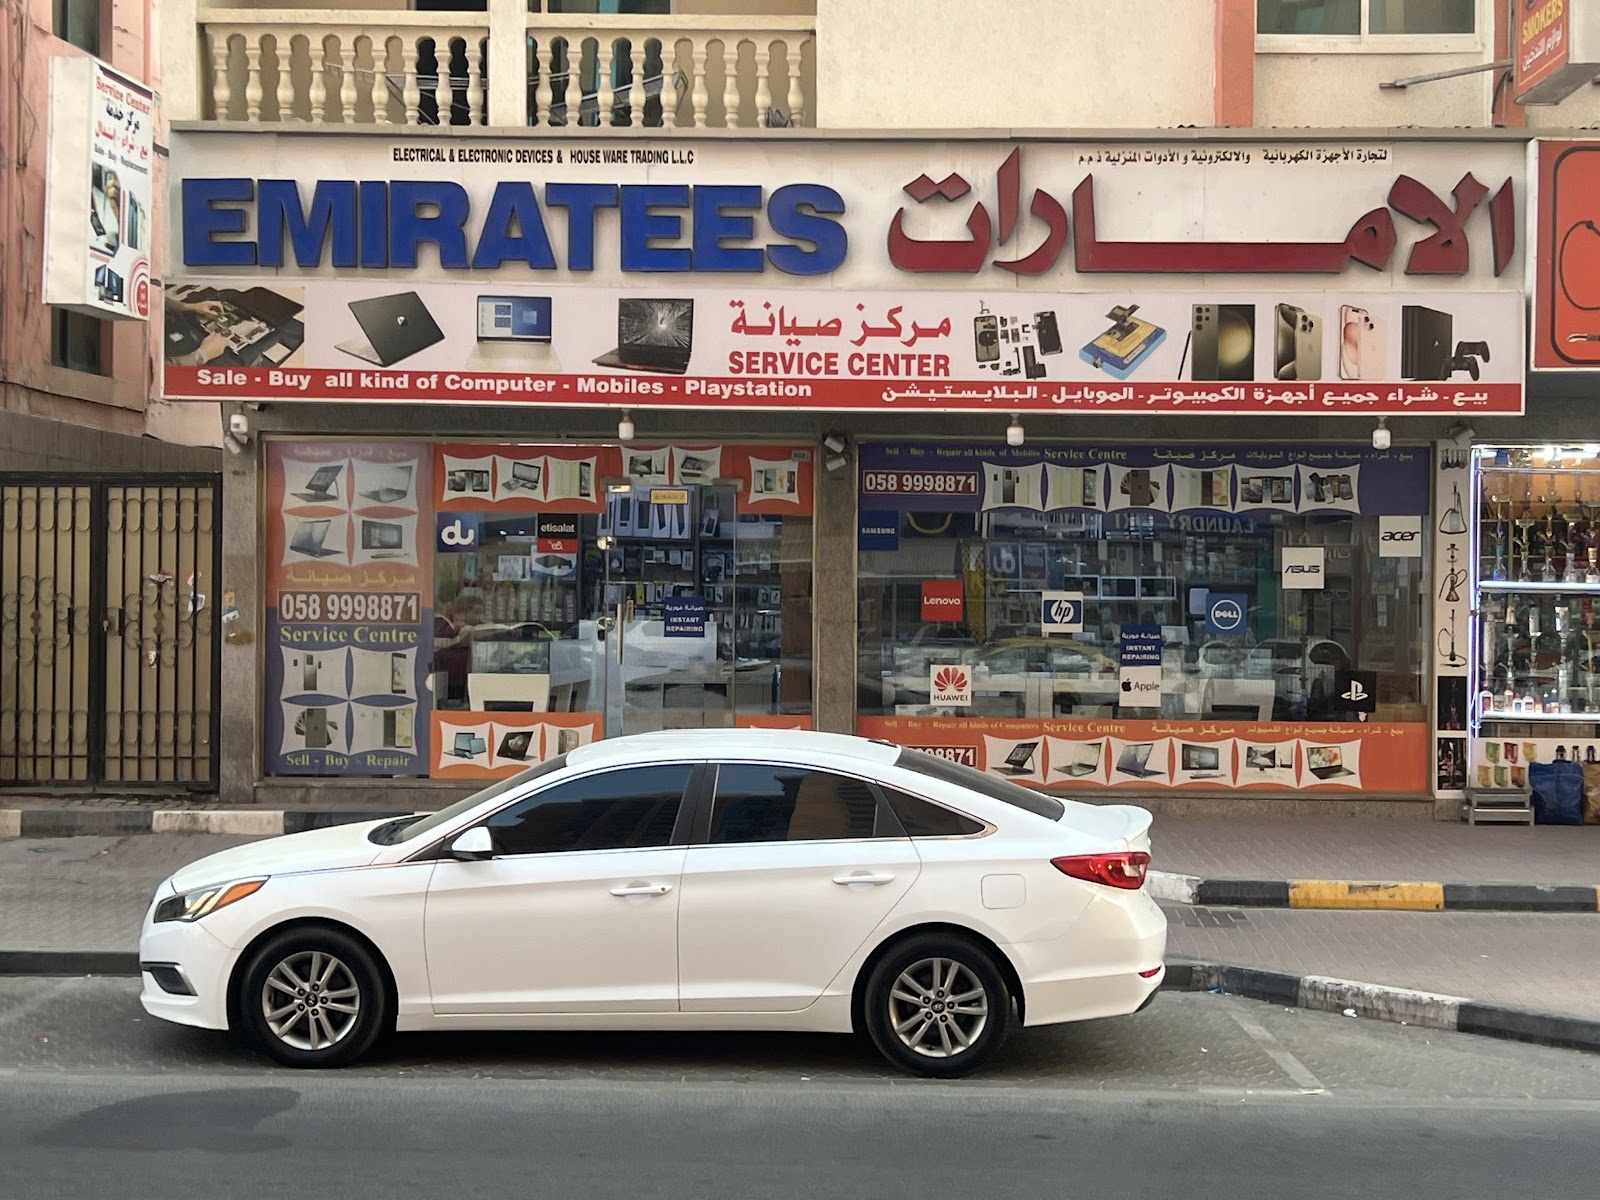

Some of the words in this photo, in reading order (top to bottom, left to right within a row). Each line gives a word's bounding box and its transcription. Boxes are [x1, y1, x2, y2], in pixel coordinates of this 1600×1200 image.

[96, 76, 123, 101] Service
[126, 92, 150, 115] Center
[125, 110, 140, 135] مركز
[393, 148, 446, 162] ELECTRICAL
[449, 149, 455, 162] &
[458, 149, 513, 163] ELECTRONIC
[515, 149, 553, 163] DEVICES
[557, 150, 563, 163] &
[570, 150, 600, 163] HOUSE
[603, 150, 628, 164] WARE
[630, 150, 669, 164] TRADING
[671, 150, 694, 164] L.L.C
[1105, 151, 1141, 165] المنزلية
[1316, 147, 1354, 163] الأجهزة
[1356, 148, 1388, 163] لتجارة
[182, 178, 848, 275] EMIRATEES
[729, 299, 843, 347] صيانة
[850, 303, 951, 347] مركز
[729, 350, 839, 375] SERVICE
[847, 352, 950, 377] CENTER
[197, 369, 247, 385] Sale
[269, 370, 311, 390] Buy
[325, 372, 352, 387] all
[360, 372, 409, 389] kind
[416, 374, 438, 389] of
[445, 374, 555, 395] Computer
[577, 377, 664, 395] Mobiles
[685, 379, 812, 400] Playstation
[882, 383, 1037, 402] البلايستيشن
[1051, 386, 1133, 404] الموبايل
[1146, 386, 1245, 405] الكمبيوتر
[1253, 383, 1315, 405] أجهزة
[1322, 391, 1379, 406] جميع
[1387, 386, 1439, 406] شراء
[1453, 391, 1488, 406] بيع
[1044, 449, 1085, 459] Service
[1089, 449, 1127, 460] Centre
[1152, 448, 1195, 460] صيانة
[1200, 450, 1236, 461] مركز
[866, 474, 897, 490] 058
[902, 475, 975, 492] 9998871
[441, 519, 474, 545] du
[541, 523, 575, 532] etisalat
[1381, 531, 1420, 541] acer
[286, 566, 352, 586] صيانة
[359, 569, 415, 587] مركز
[281, 594, 321, 620] 058
[327, 594, 417, 621] 9998871
[924, 596, 961, 605] Lenovo
[1054, 600, 1071, 623] hp
[1215, 610, 1238, 619] DELL
[280, 626, 347, 643] Service
[354, 627, 417, 643] Centre
[1134, 681, 1160, 692] Apple
[1043, 722, 1083, 732] Service
[1087, 722, 1126, 733] Centre
[1151, 722, 1194, 733] صيانة
[1199, 724, 1235, 735] مركز
[286, 754, 310, 766] Sell
[325, 755, 351, 768] Buy
[367, 755, 410, 768] Repair
